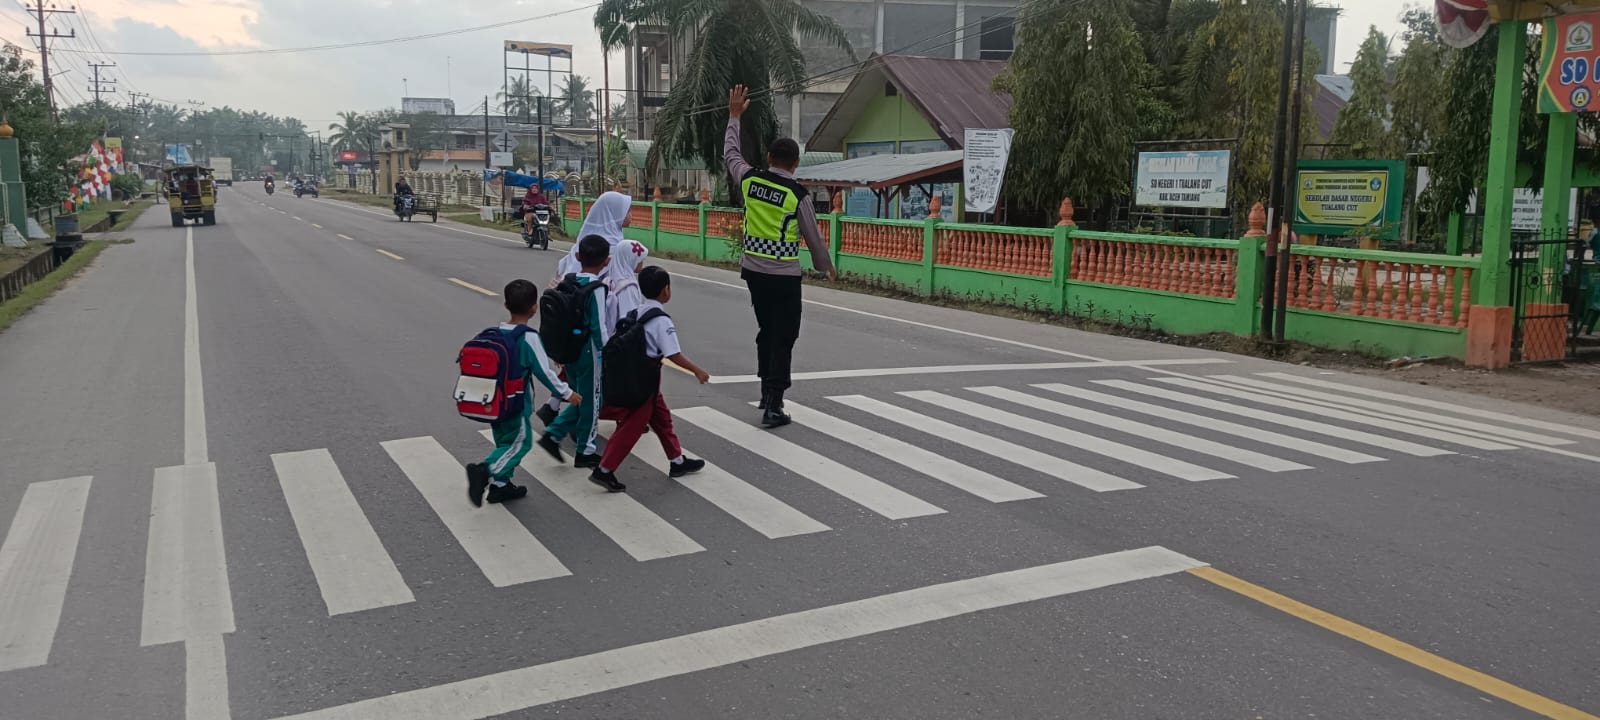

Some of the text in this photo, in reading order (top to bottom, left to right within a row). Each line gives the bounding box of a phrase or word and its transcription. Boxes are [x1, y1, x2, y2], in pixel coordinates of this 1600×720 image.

[1561, 57, 1589, 85] SD
[1158, 179, 1174, 189] NEGERI
[1201, 179, 1212, 189] CUT
[750, 184, 784, 204] POLISI
[1331, 194, 1349, 202] DASAR
